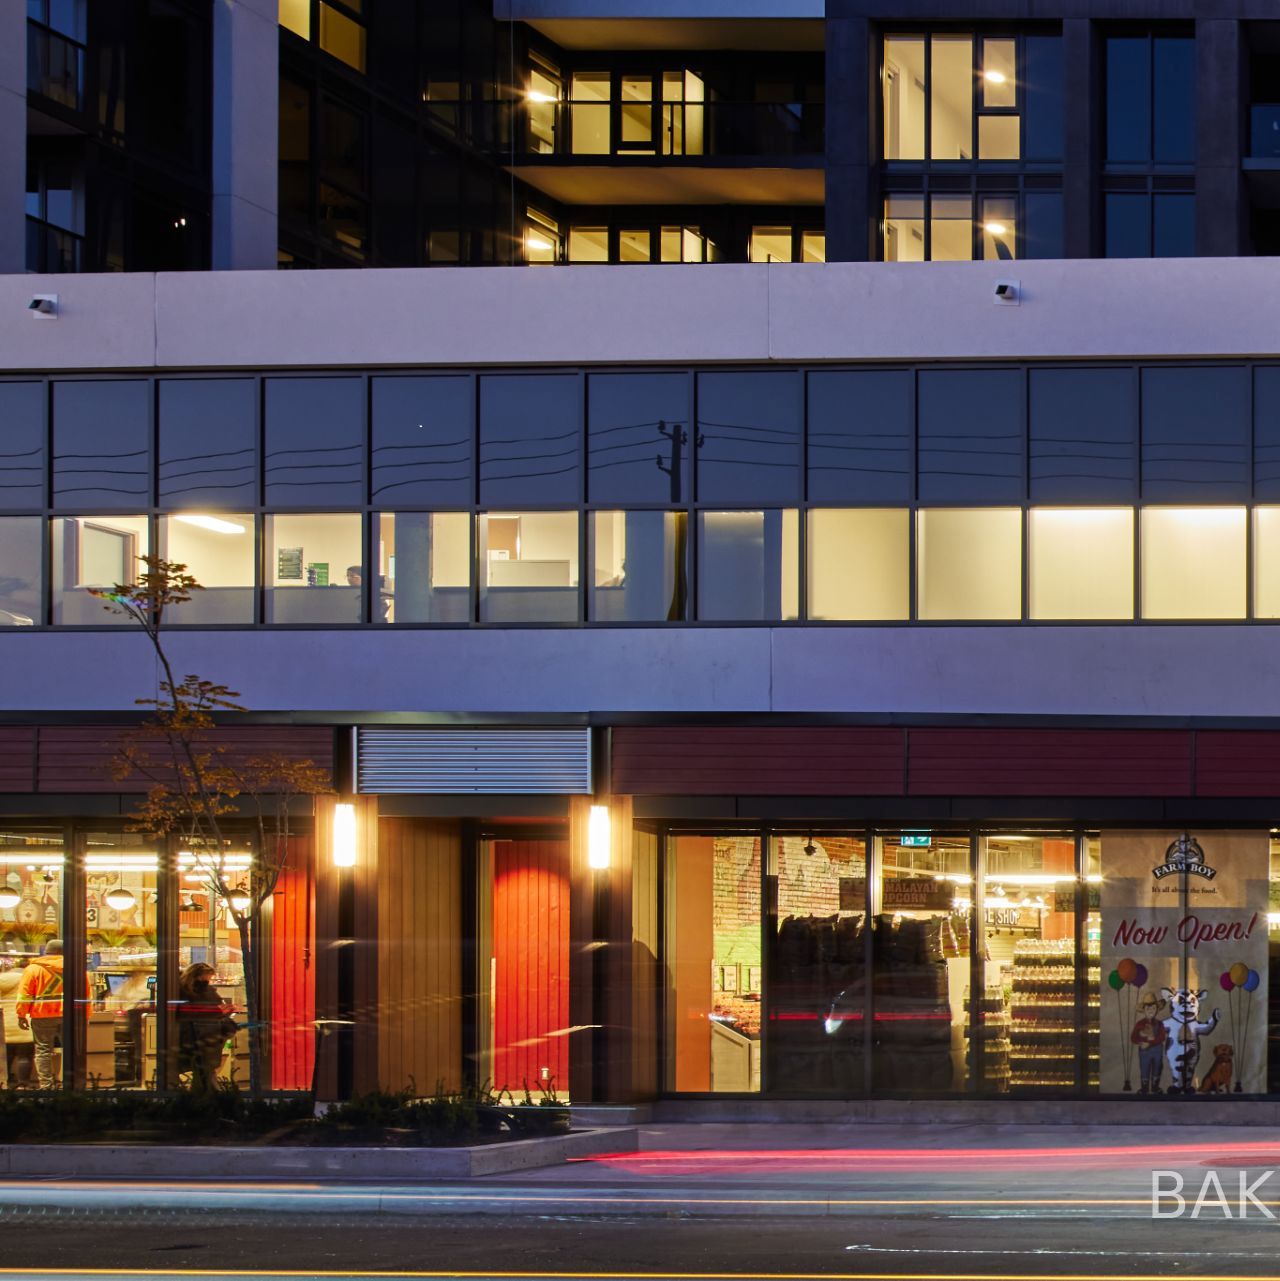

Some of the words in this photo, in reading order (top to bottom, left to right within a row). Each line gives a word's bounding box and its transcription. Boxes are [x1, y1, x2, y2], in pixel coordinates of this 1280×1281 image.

[1154, 862, 1186, 877] FARM
[1190, 863, 1215, 877] BOY
[1112, 919, 1169, 948] Now
[1177, 912, 1259, 950] Open!
